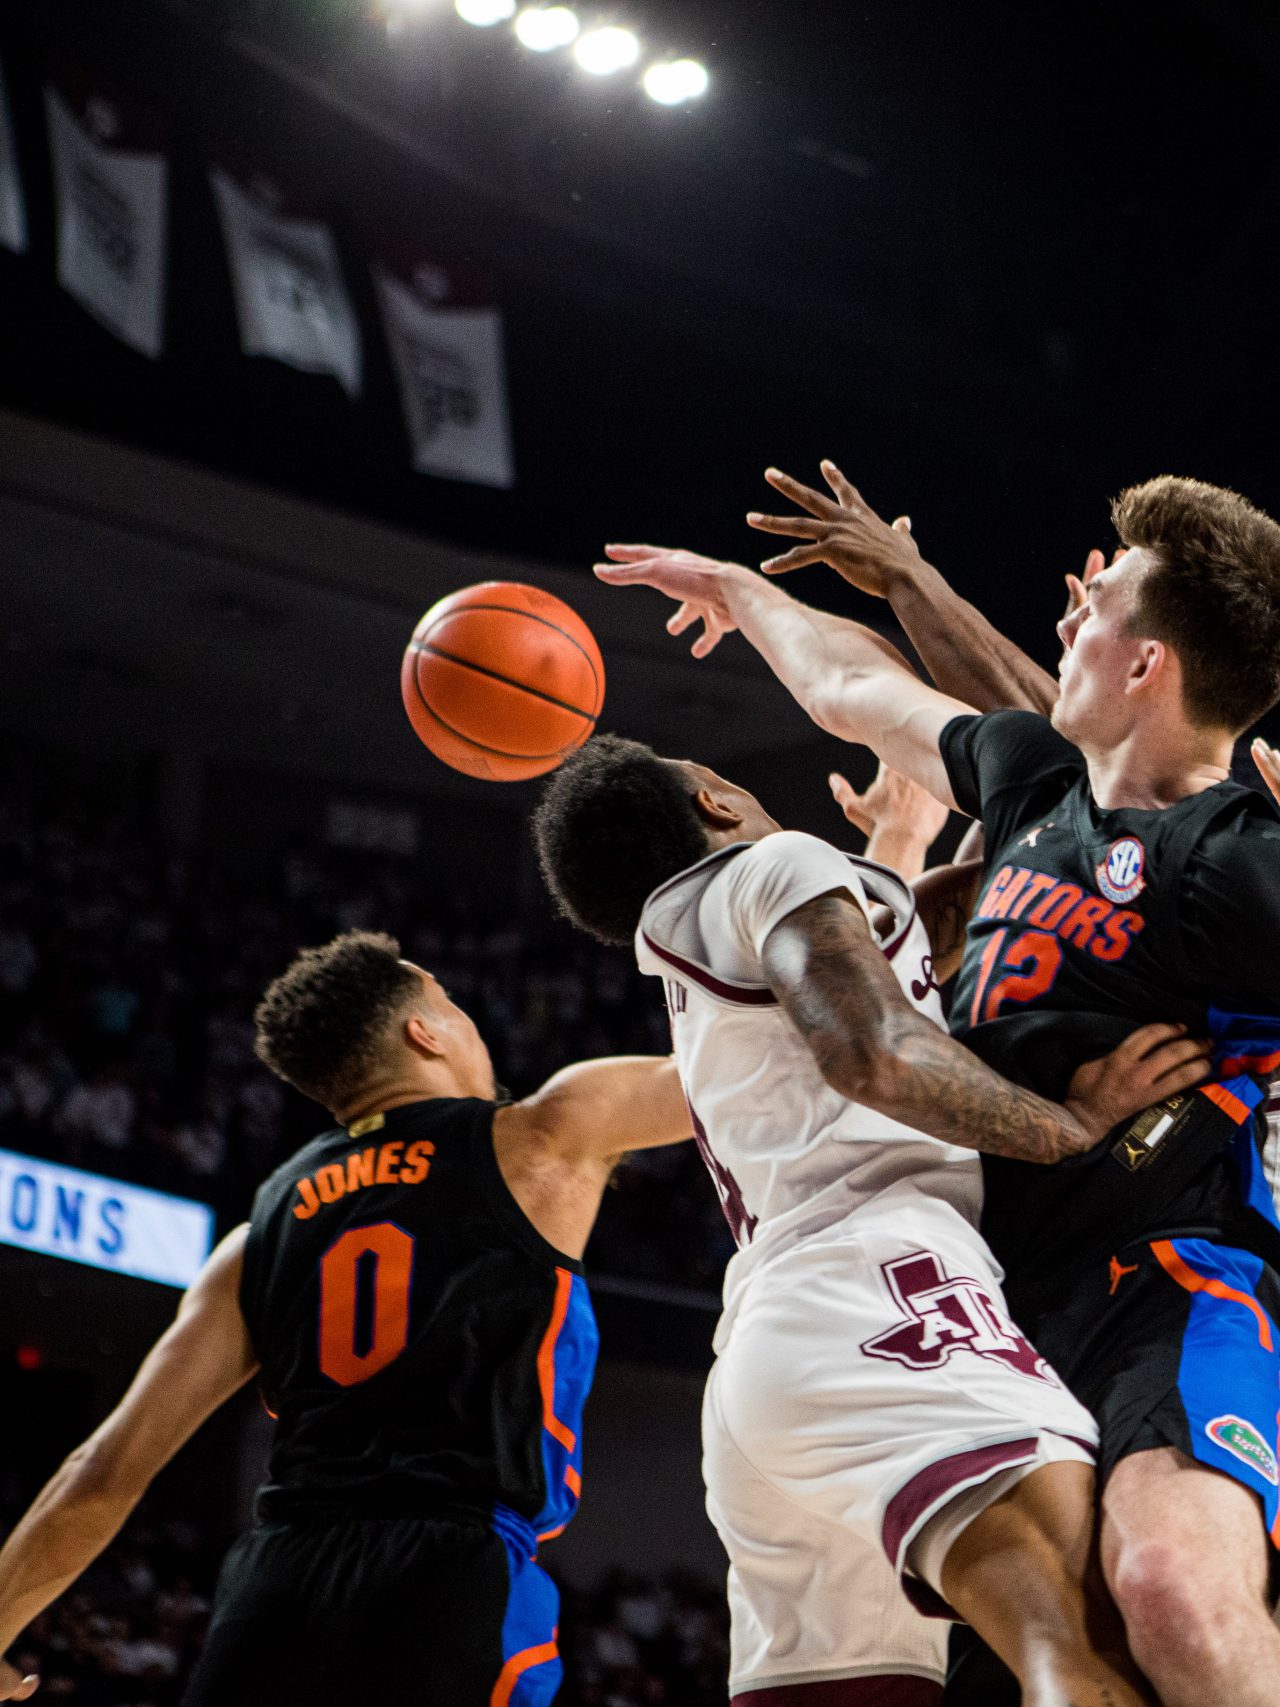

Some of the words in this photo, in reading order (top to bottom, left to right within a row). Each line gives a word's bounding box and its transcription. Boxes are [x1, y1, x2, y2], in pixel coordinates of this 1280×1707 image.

[1108, 840, 1140, 887] SEC
[978, 865, 1146, 962] GATORS
[970, 928, 1063, 1028] 12
[293, 1140, 436, 1220] JONES
[318, 1220, 416, 1387] 0
